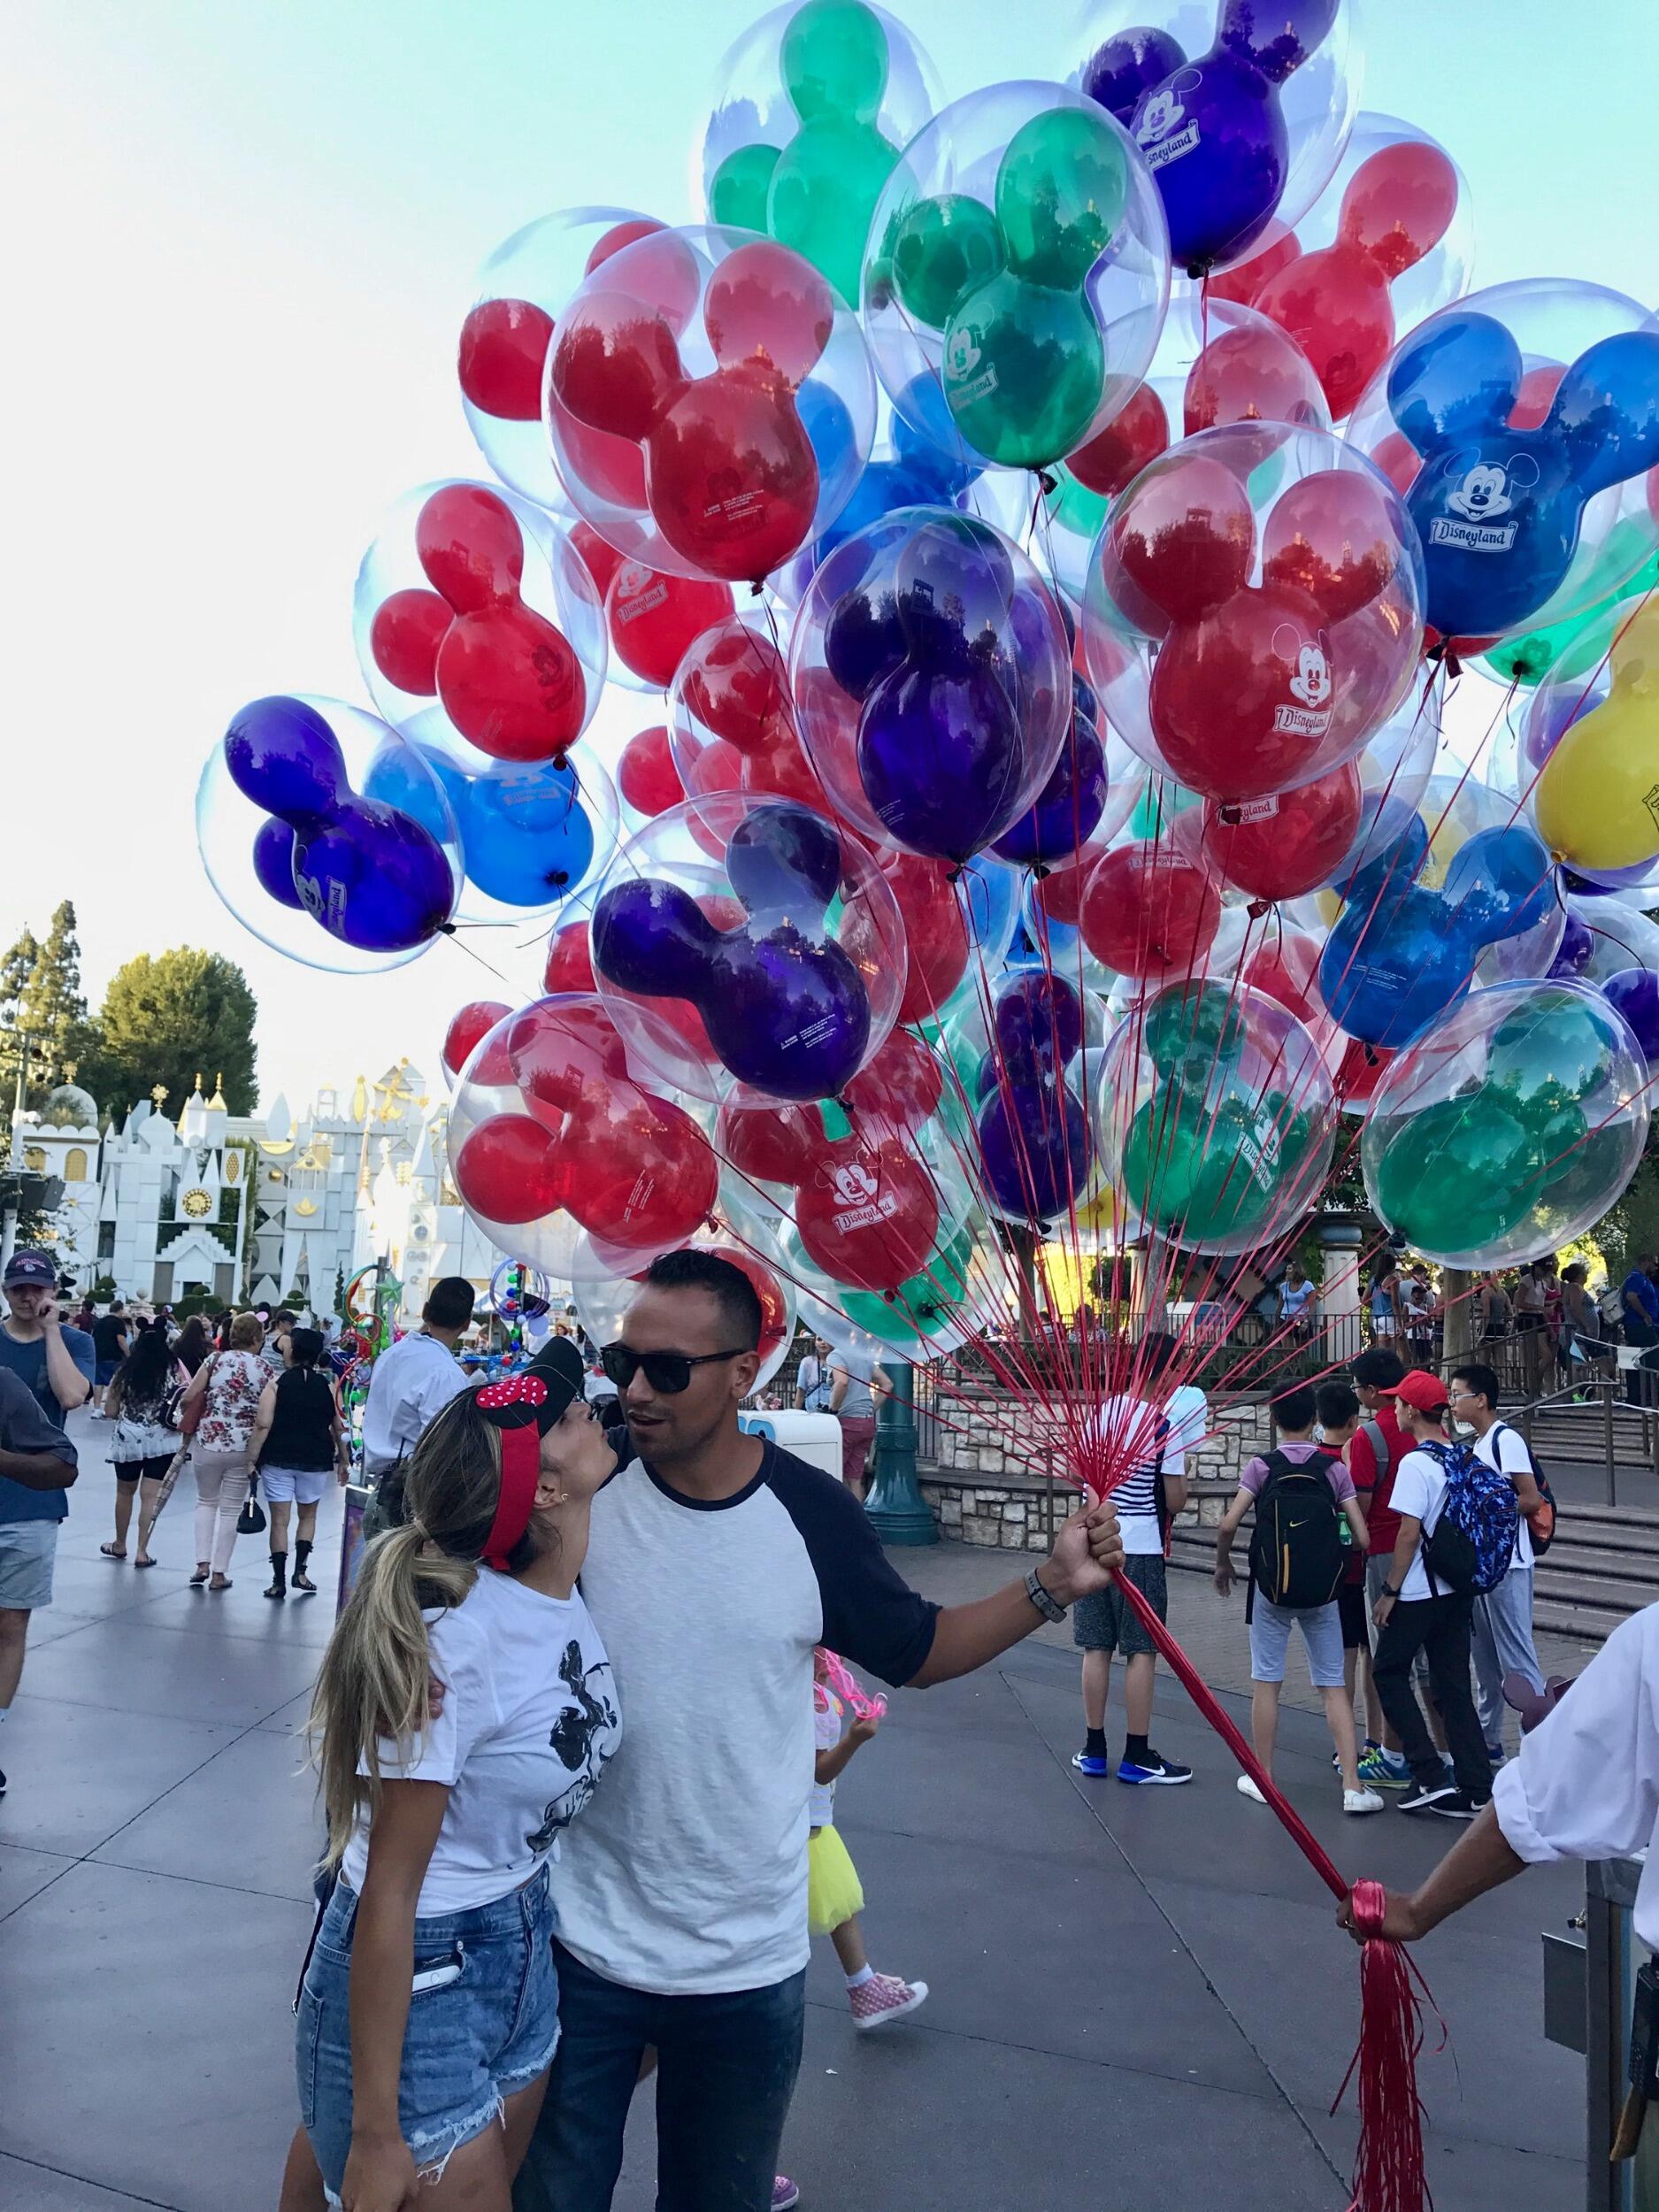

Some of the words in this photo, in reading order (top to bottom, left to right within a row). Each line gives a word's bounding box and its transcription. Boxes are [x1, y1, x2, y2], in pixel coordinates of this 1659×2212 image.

[1148, 132, 1193, 165] sneyland
[1437, 521, 1506, 547] Disneyland
[1282, 708, 1326, 733] Disneylan
[1240, 800, 1271, 821] eyland
